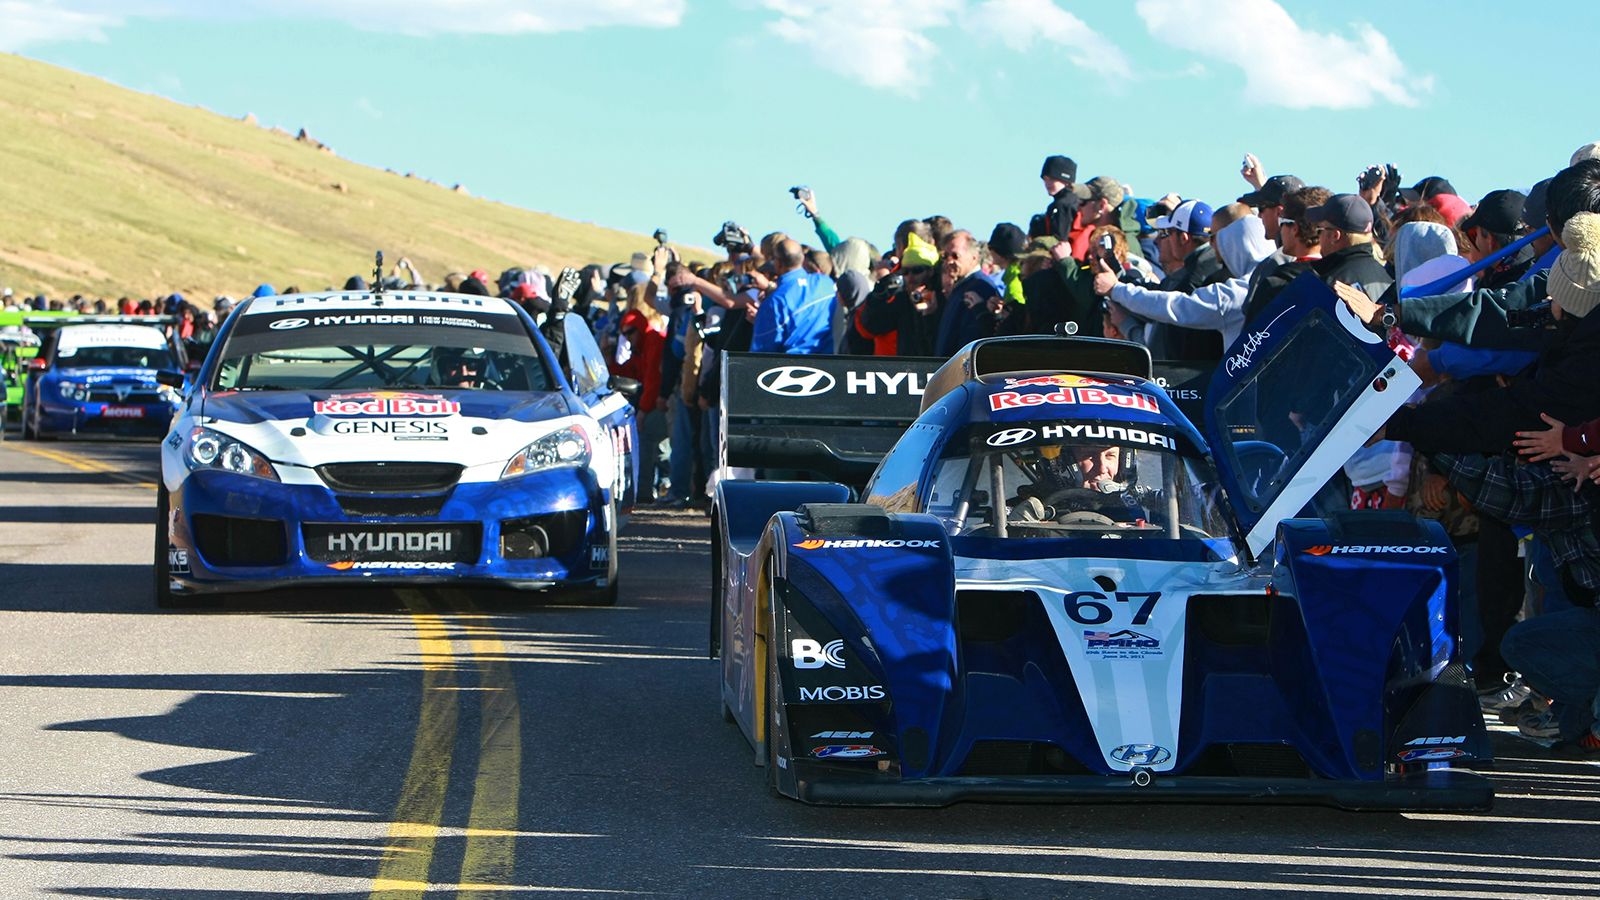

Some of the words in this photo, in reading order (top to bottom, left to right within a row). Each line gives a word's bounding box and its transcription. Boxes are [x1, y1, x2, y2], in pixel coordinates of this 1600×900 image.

[314, 315, 414, 326] HYUNDAI
[314, 399, 386, 416] Red
[389, 399, 461, 415] Bull
[989, 388, 1076, 412] Red
[1077, 388, 1161, 415] Bull
[333, 420, 448, 434] GENESIS
[1042, 425, 1177, 450] HYUNDAI
[327, 532, 452, 551] HYUNDAI
[592, 548, 610, 562] HK
[1063, 591, 1162, 625] 67
[799, 685, 886, 701] MOBIS
[809, 730, 875, 739] AEM
[1403, 735, 1467, 746] AEM
